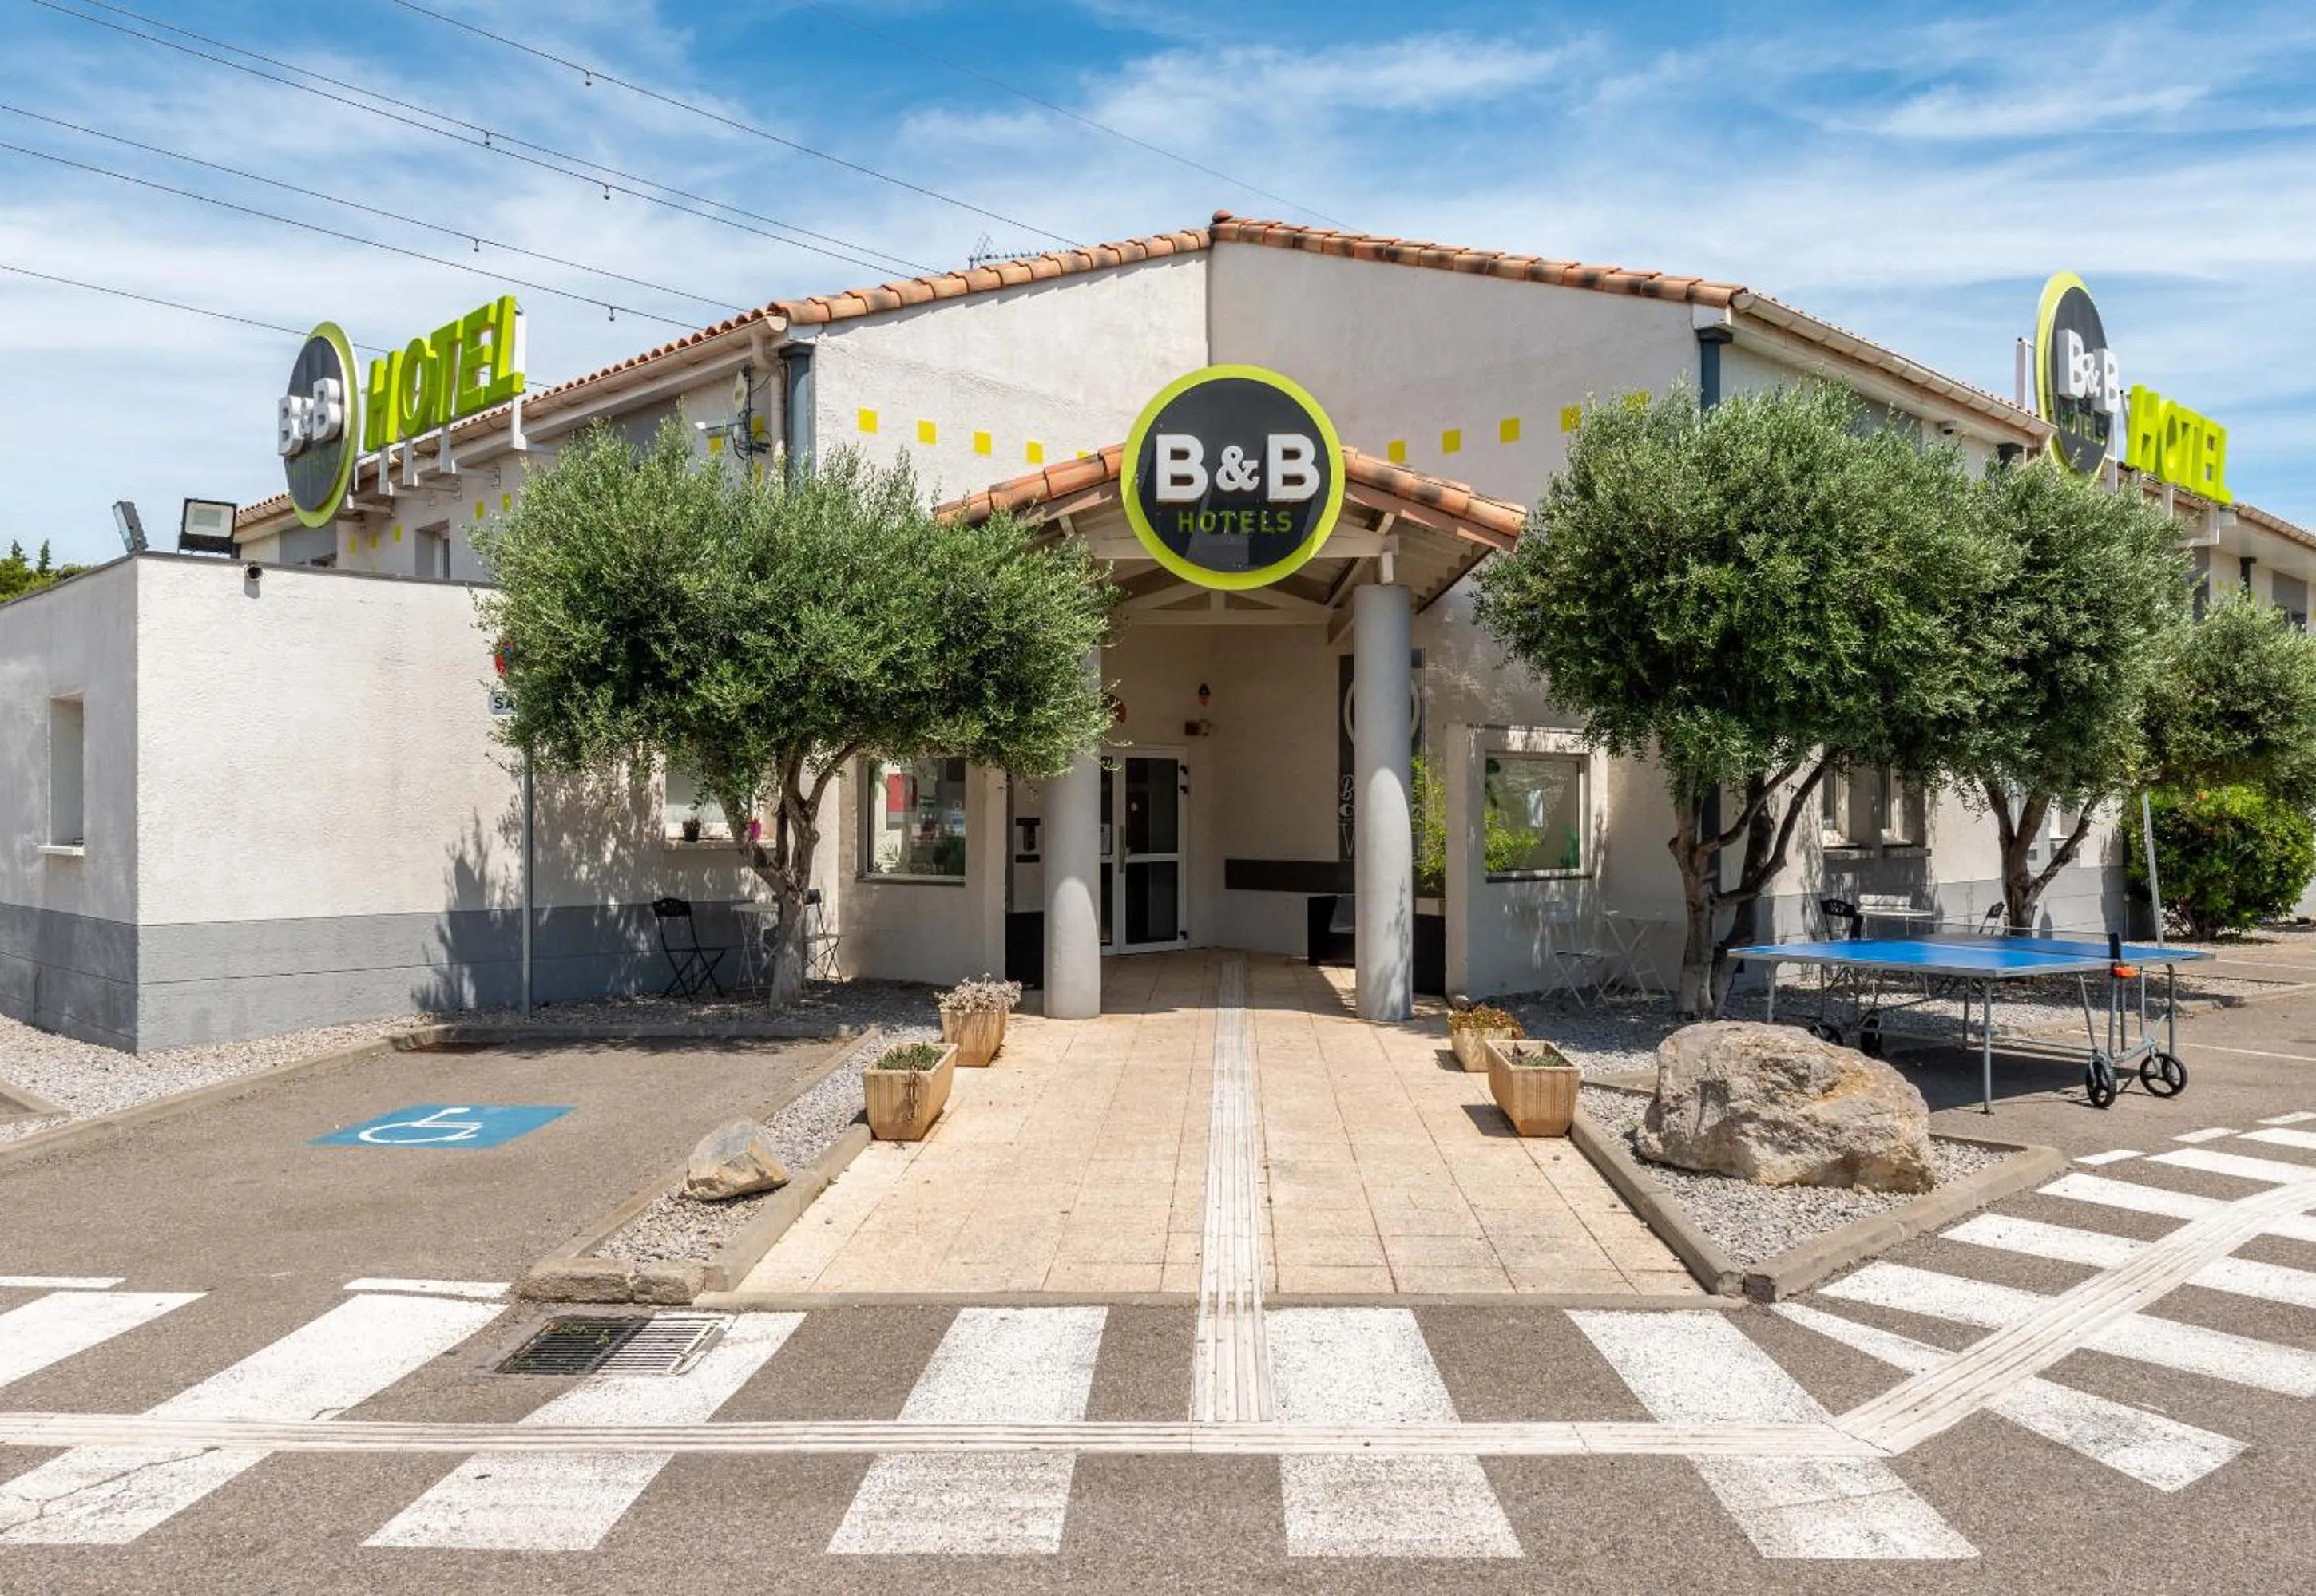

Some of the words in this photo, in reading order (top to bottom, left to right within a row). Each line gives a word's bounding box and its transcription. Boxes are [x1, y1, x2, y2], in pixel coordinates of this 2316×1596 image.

[365, 295, 525, 451] HOTEL
[2056, 329, 2120, 415] B&B
[278, 378, 341, 456] B&B
[2128, 385, 2233, 505] HOTEL
[1156, 434, 1320, 501] B&B
[1179, 511, 1292, 534] HOTELS
